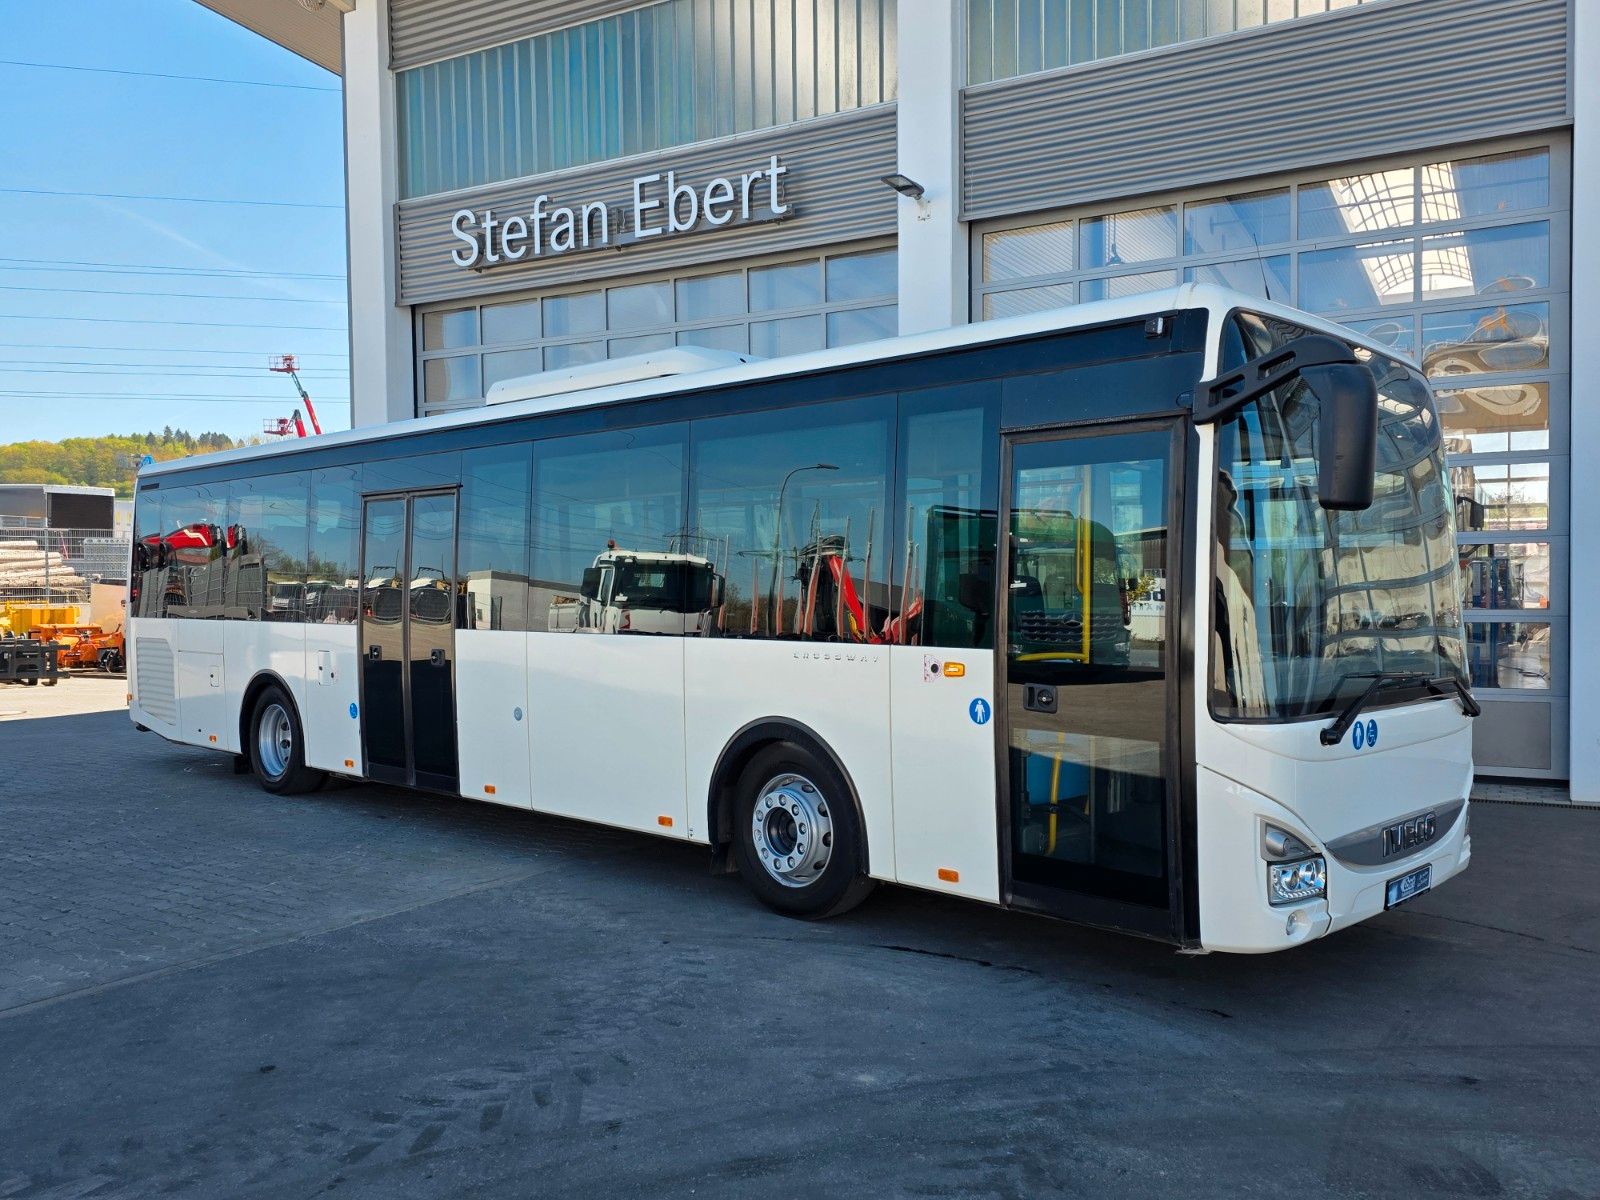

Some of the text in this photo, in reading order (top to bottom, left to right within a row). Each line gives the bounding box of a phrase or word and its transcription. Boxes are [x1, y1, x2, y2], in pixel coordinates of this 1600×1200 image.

[450, 155, 789, 268] Stefan Ebert
[1382, 811, 1437, 858] IVECO
